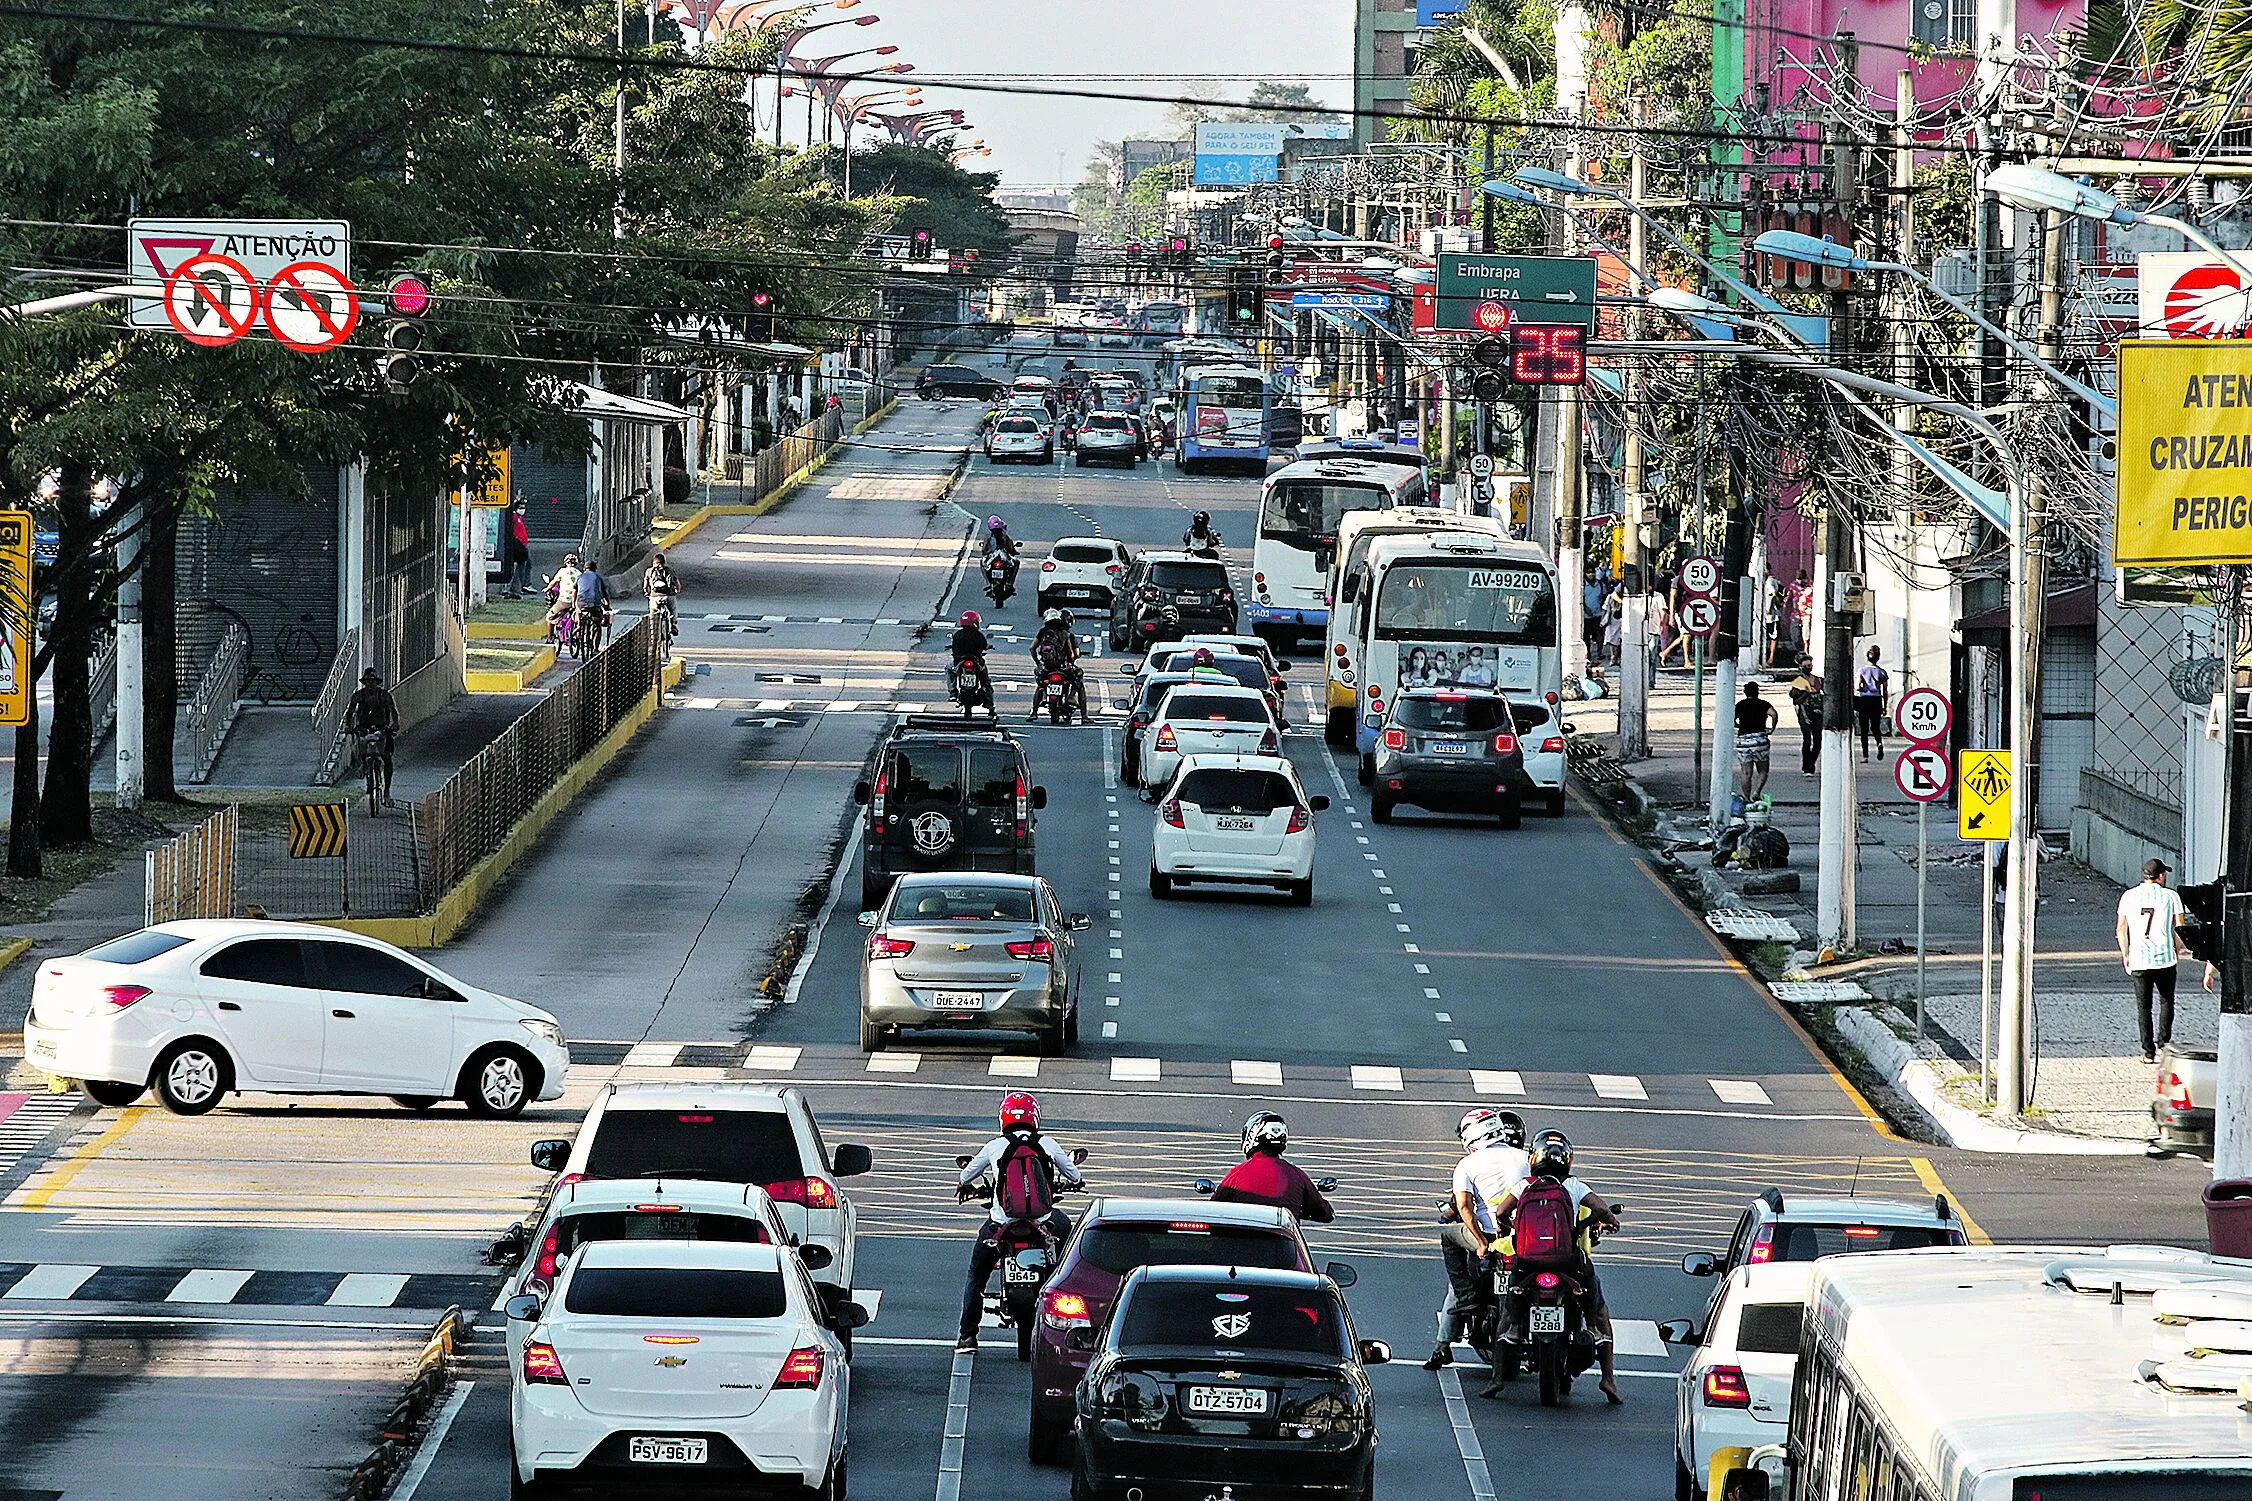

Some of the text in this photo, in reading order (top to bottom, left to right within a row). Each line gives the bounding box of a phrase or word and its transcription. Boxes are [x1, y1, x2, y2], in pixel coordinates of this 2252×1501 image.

[1205, 141, 1227, 149] PARA
[223, 231, 336, 262] ATENÇÃO
[1457, 262, 1521, 281] Embrapa
[1516, 329, 1580, 380] 25
[2183, 374, 2252, 408] ATEN
[1475, 459, 1489, 468] 50
[2172, 495, 2252, 531] PERIG
[1690, 565, 1710, 579] 50
[1471, 572, 1540, 589] AV-99209
[1911, 701, 1938, 721] 50
[1911, 722, 1937, 731] Km/h
[2140, 907, 2155, 938] 7
[1009, 1271, 1036, 1281] 9645
[1533, 1321, 1561, 1331] 9288
[1193, 1395, 1263, 1410] OTZ-5704
[632, 1445, 704, 1461] PSV-9617
